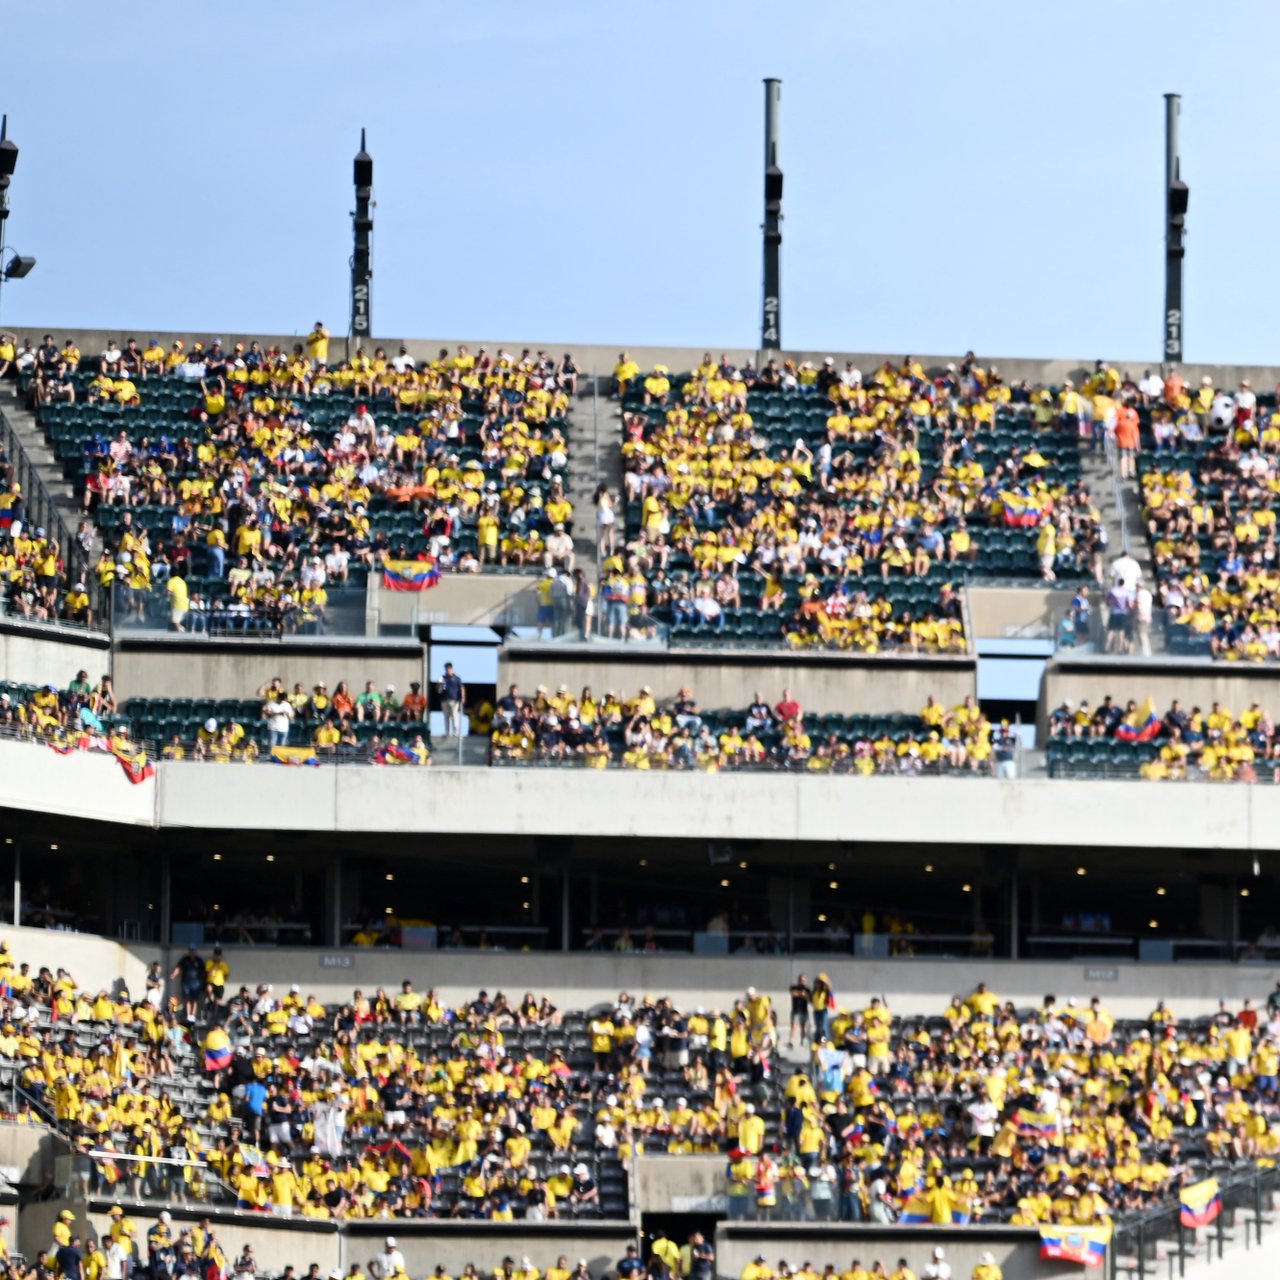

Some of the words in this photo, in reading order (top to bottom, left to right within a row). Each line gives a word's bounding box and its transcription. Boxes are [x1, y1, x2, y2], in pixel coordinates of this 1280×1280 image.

[354, 284, 368, 330] 215
[764, 296, 778, 341] 214
[1166, 309, 1180, 354] 213
